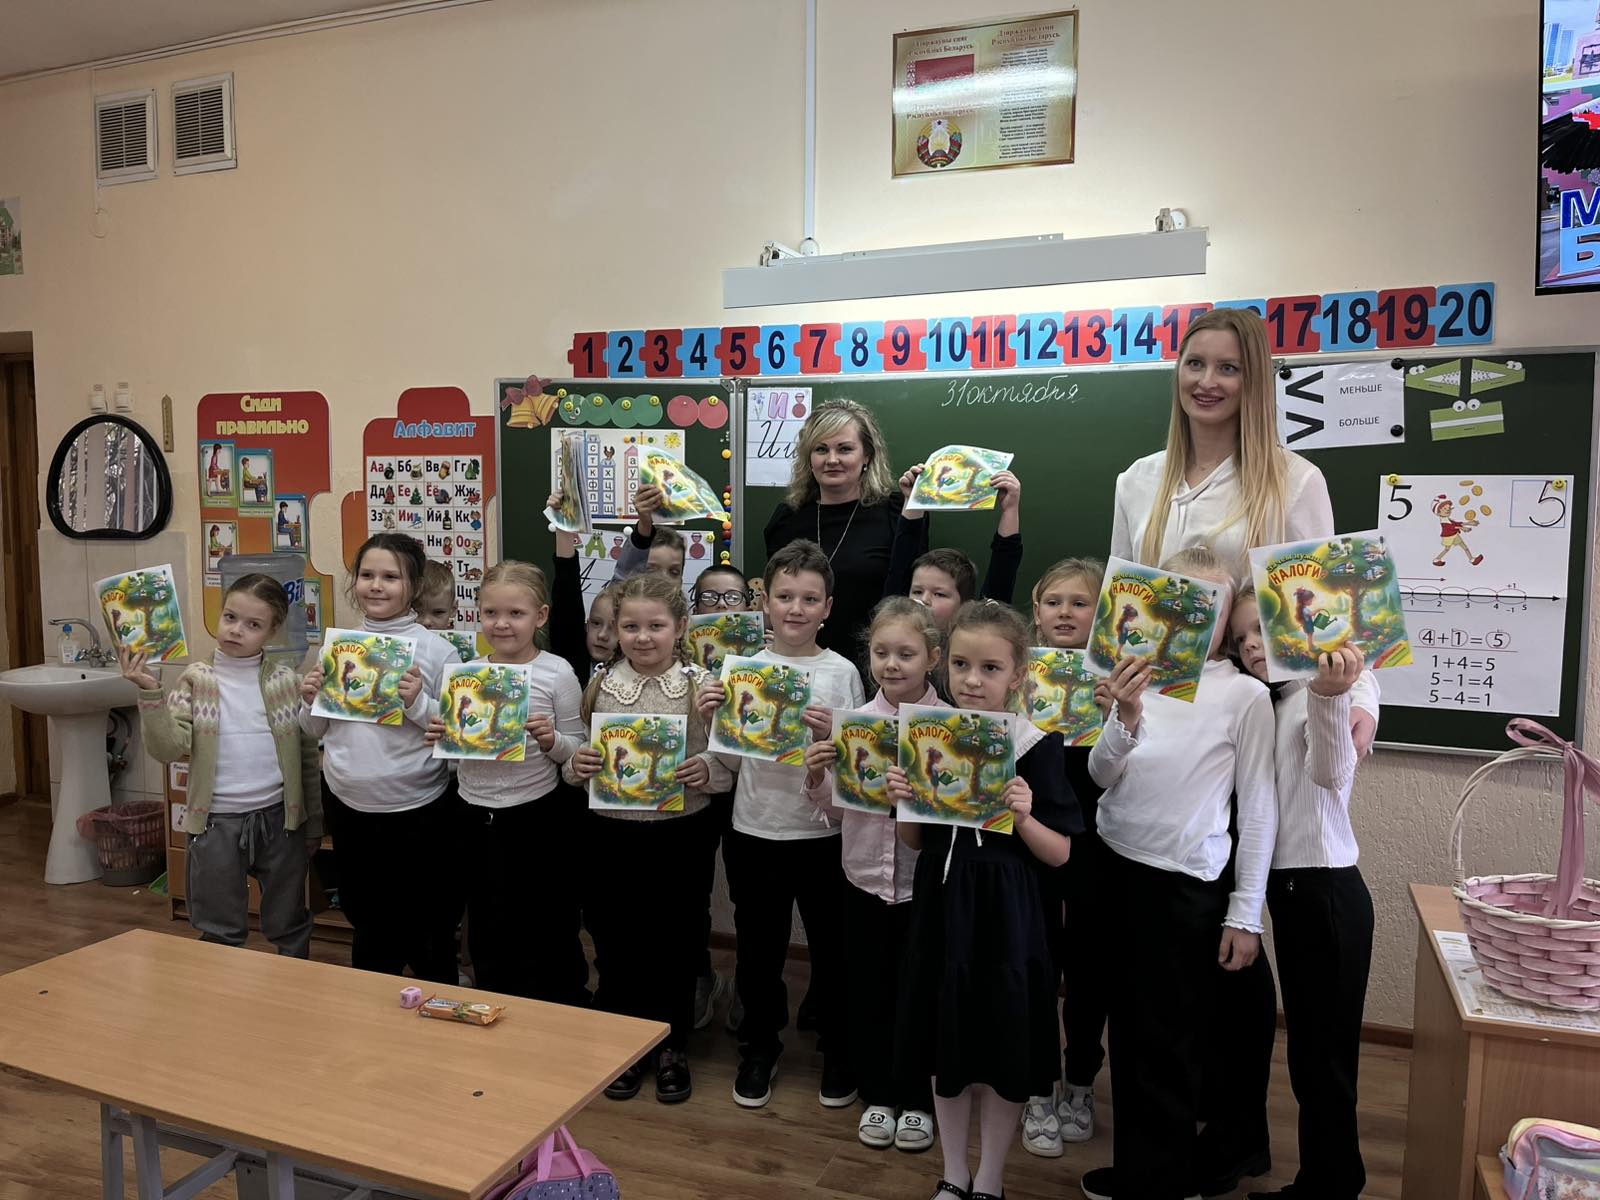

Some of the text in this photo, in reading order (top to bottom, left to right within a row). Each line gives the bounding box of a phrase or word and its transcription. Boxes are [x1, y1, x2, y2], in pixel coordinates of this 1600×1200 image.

[582, 337, 593, 373] 1
[617, 336, 634, 373] 2
[653, 335, 670, 372] 3
[690, 332, 708, 371] 4
[730, 332, 746, 371] 5
[768, 330, 785, 370] 6
[809, 329, 827, 368] 7
[850, 327, 869, 367] 8
[892, 325, 910, 366] 9
[928, 321, 968, 363] 10
[973, 320, 1006, 363] 11
[1016, 318, 1058, 361] 12
[1064, 316, 1106, 358] 13
[1112, 312, 1157, 356] 14
[1268, 302, 1317, 348] 17
[1322, 298, 1371, 345] 18
[1378, 294, 1429, 341] 19
[1439, 289, 1492, 338] 20
[1339, 384, 1383, 395] МЕНЬШЕ
[240, 394, 282, 412] Сиди
[216, 419, 310, 435] правильно
[393, 419, 476, 438] Алфавит
[1339, 416, 1380, 428] БОЛЬШЕ
[370, 459, 467, 473] Аа Бб Вв Гг
[370, 482, 476, 499] Дд Ее Ёё Жж
[1387, 484, 1414, 520] 5
[1529, 480, 1566, 528] 5
[371, 508, 470, 523] Зз Ии Йй Кк
[427, 535, 471, 548] Нн Оо
[456, 560, 470, 572] Тт
[457, 585, 472, 600] Цц
[1436, 600, 1442, 608] 2
